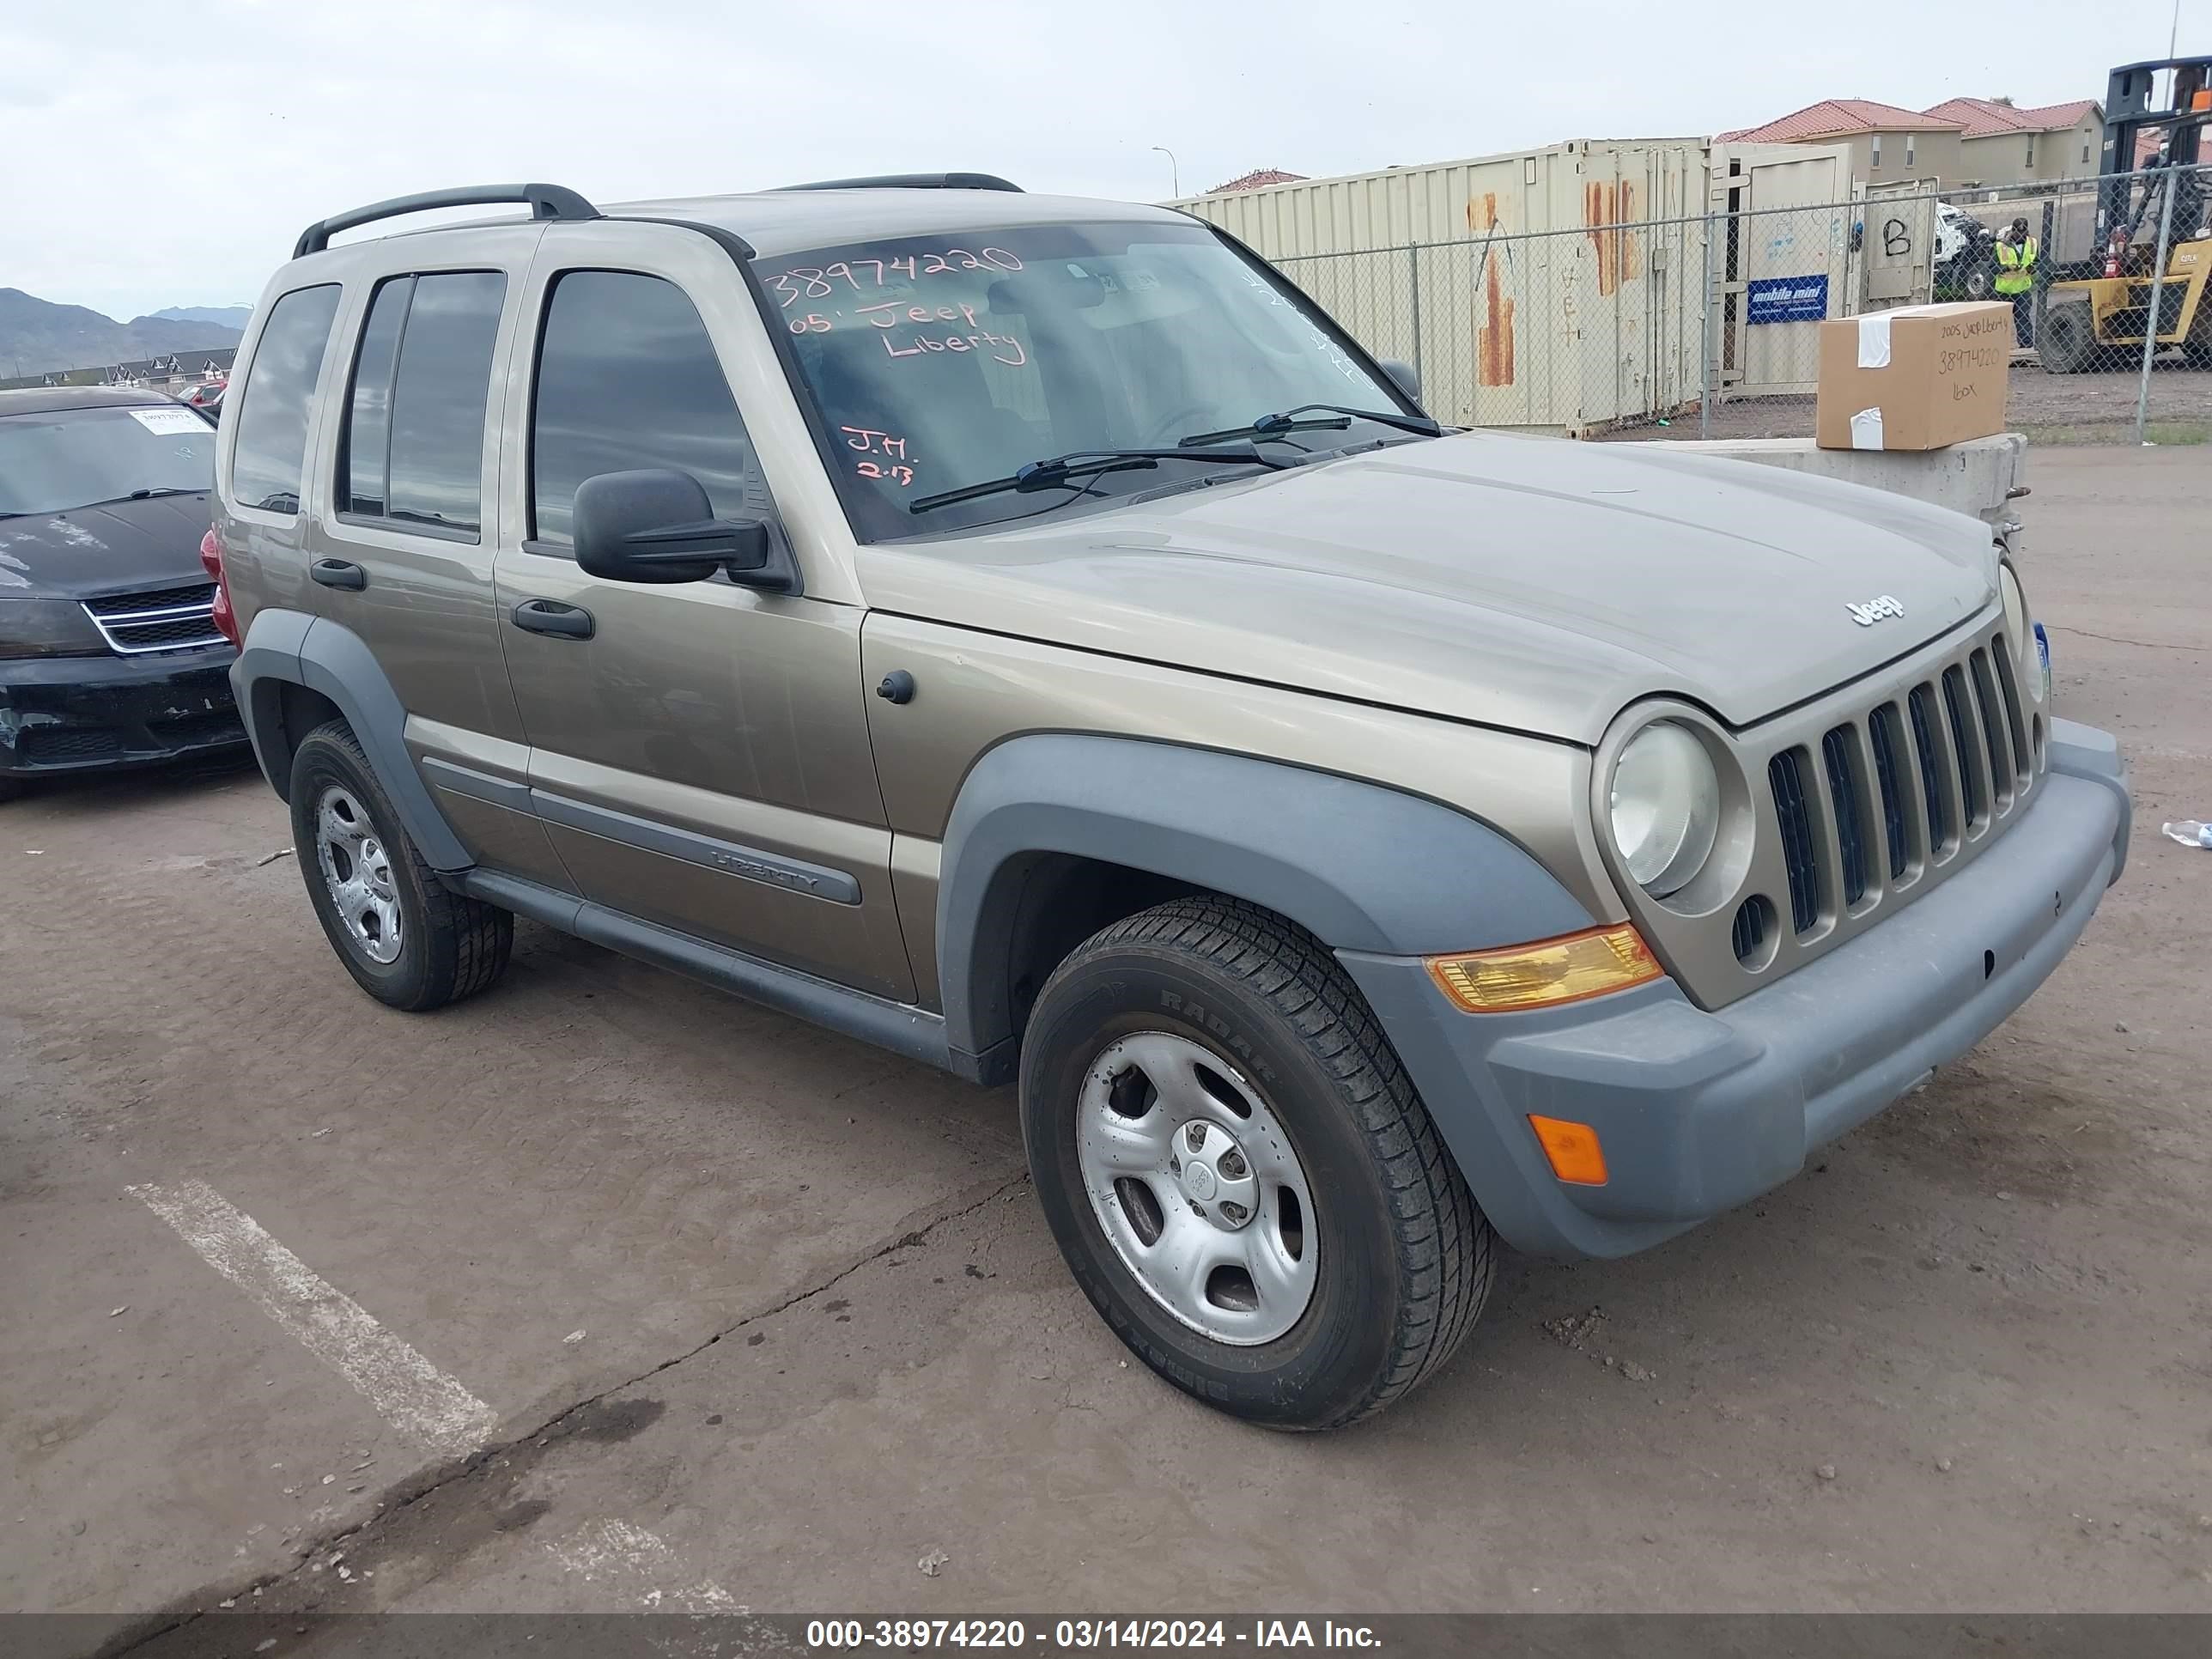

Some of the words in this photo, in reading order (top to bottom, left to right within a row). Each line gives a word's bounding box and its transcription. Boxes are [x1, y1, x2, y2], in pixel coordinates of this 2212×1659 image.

[1882, 218, 1911, 256] B
[763, 247, 1024, 308] 38974220
[1753, 287, 1793, 302] mobile
[1793, 285, 1822, 299] mini
[854, 301, 978, 328] Jeep
[882, 332, 1026, 367] Liberty
[1938, 348, 2000, 374] 38974220
[857, 462, 914, 486] 2.13
[1844, 594, 1905, 627] Jeep
[710, 851, 818, 889] LIBERTY
[1160, 989, 1278, 1082] RADAR
